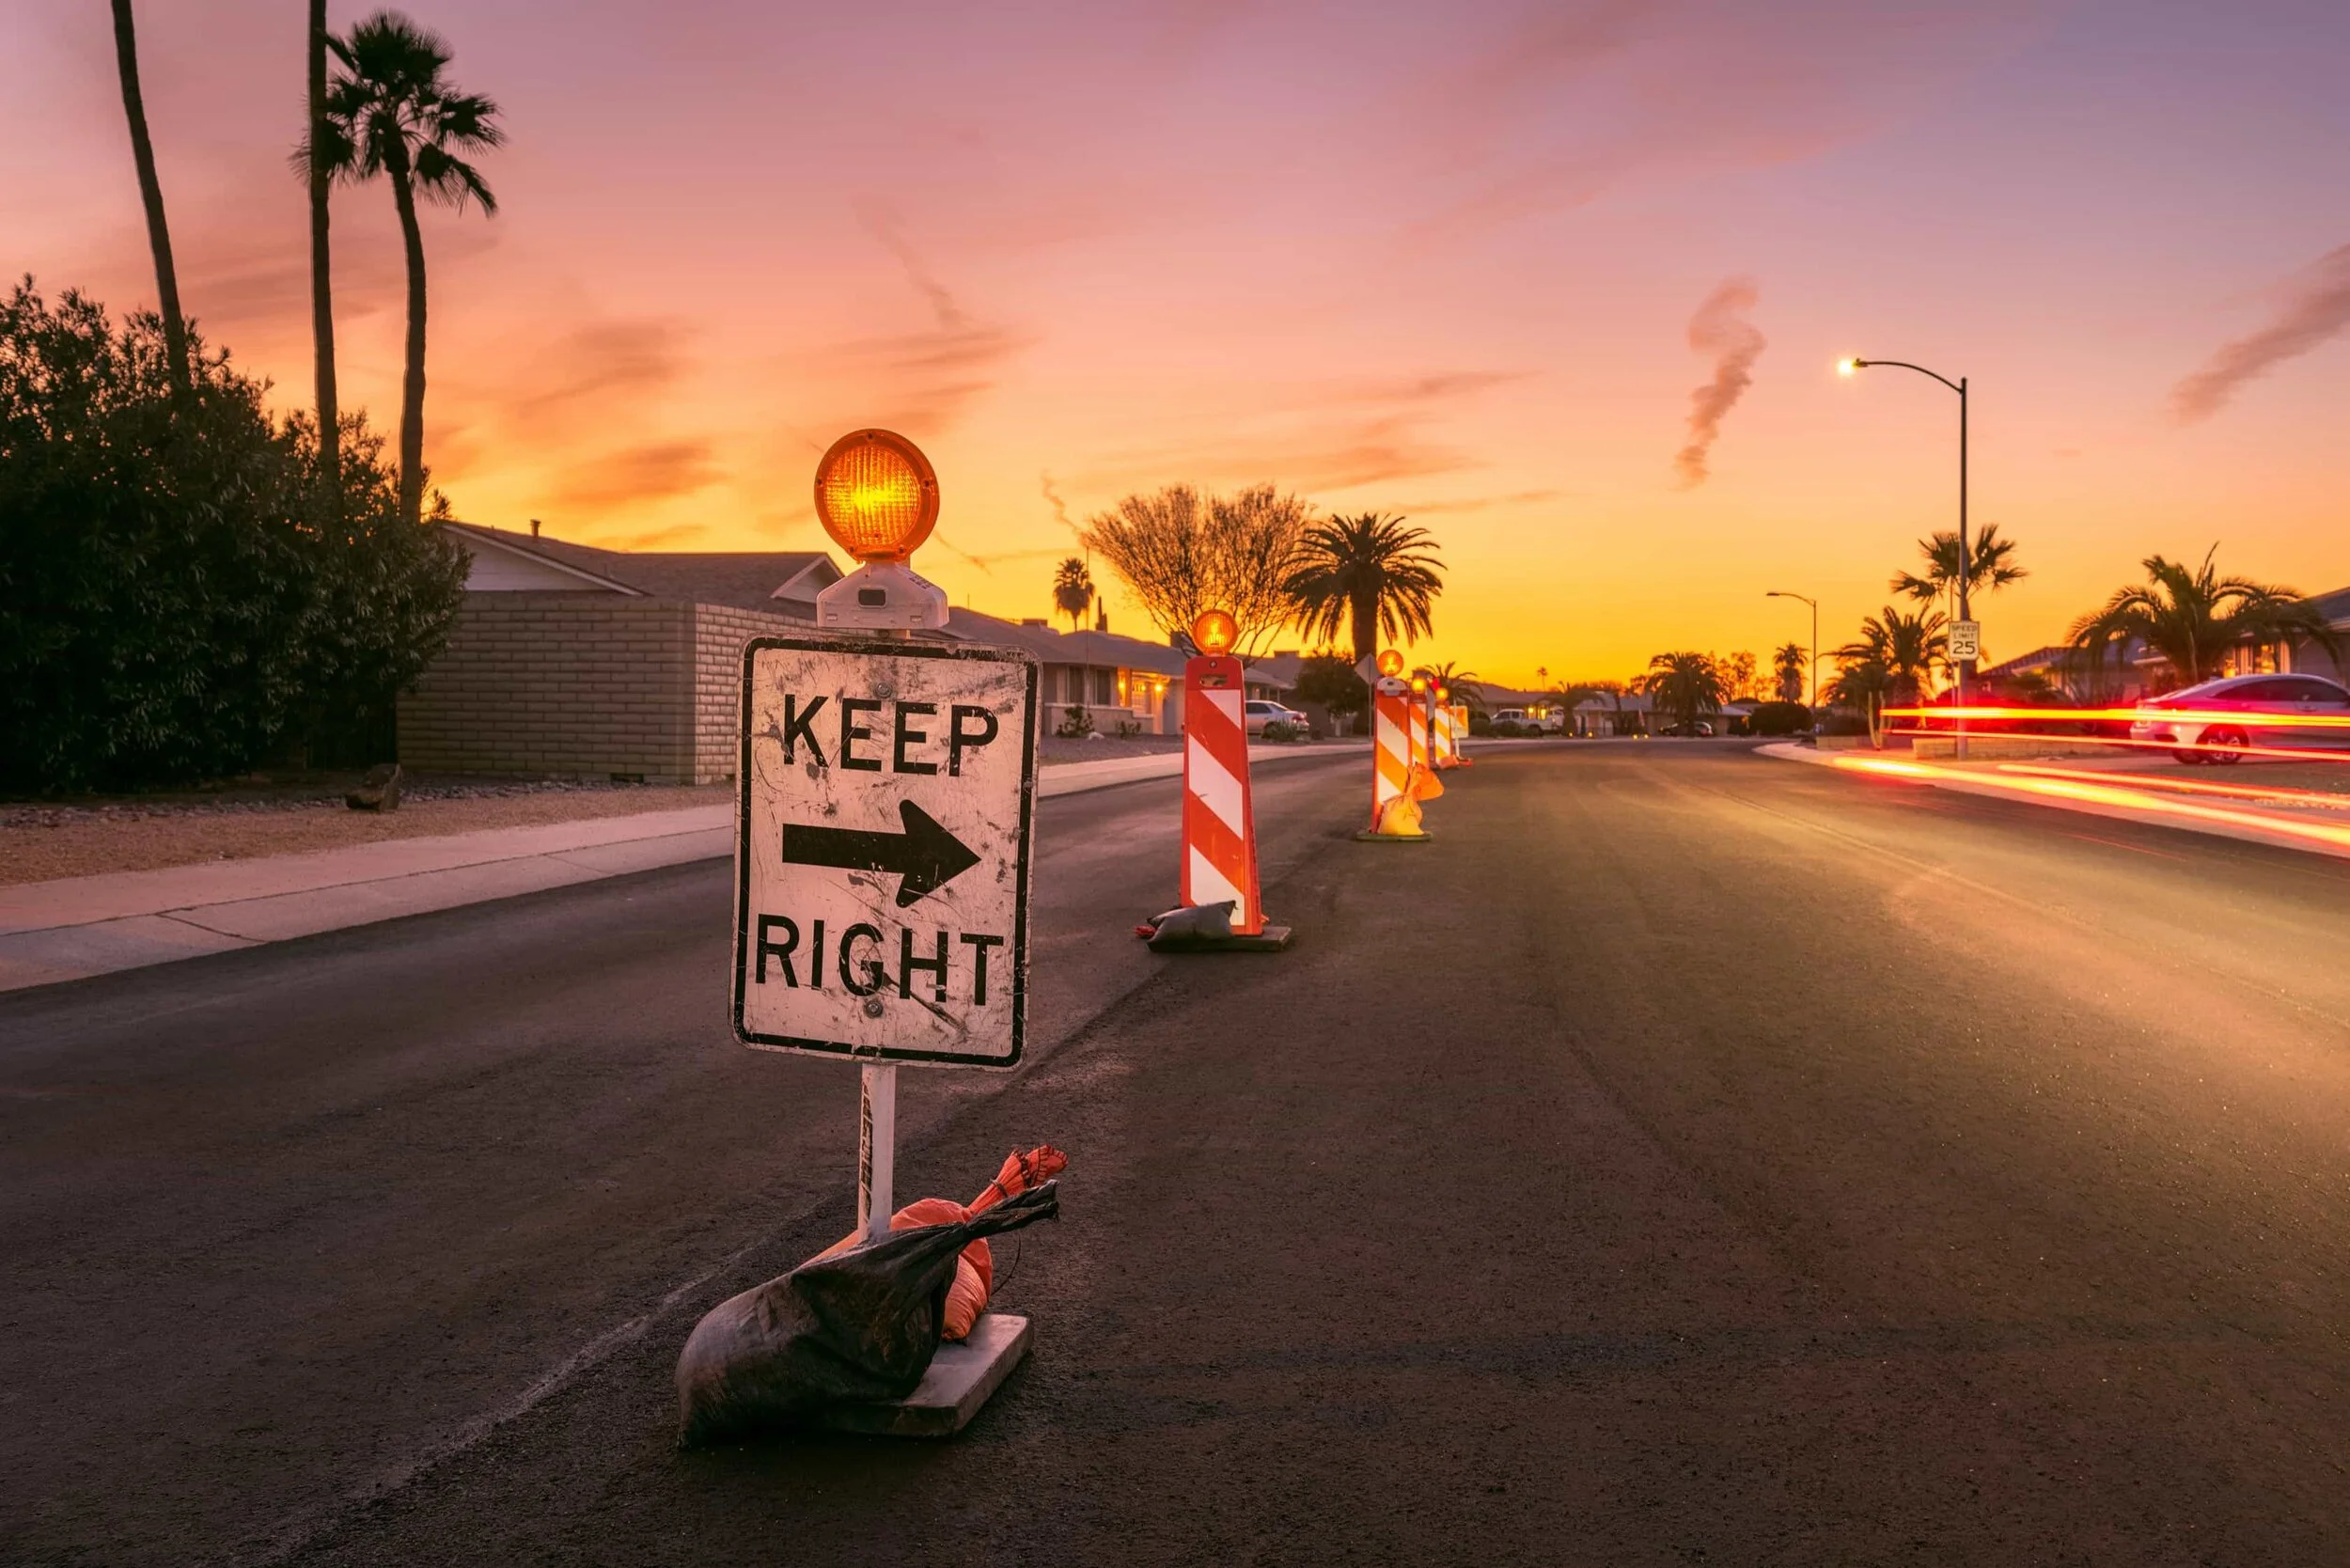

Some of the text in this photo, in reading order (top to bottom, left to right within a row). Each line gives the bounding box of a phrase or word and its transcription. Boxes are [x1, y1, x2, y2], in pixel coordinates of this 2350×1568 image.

[1953, 640, 1976, 655] 25
[783, 694, 999, 777] KEEP
[755, 914, 1004, 1006] RIGHT
